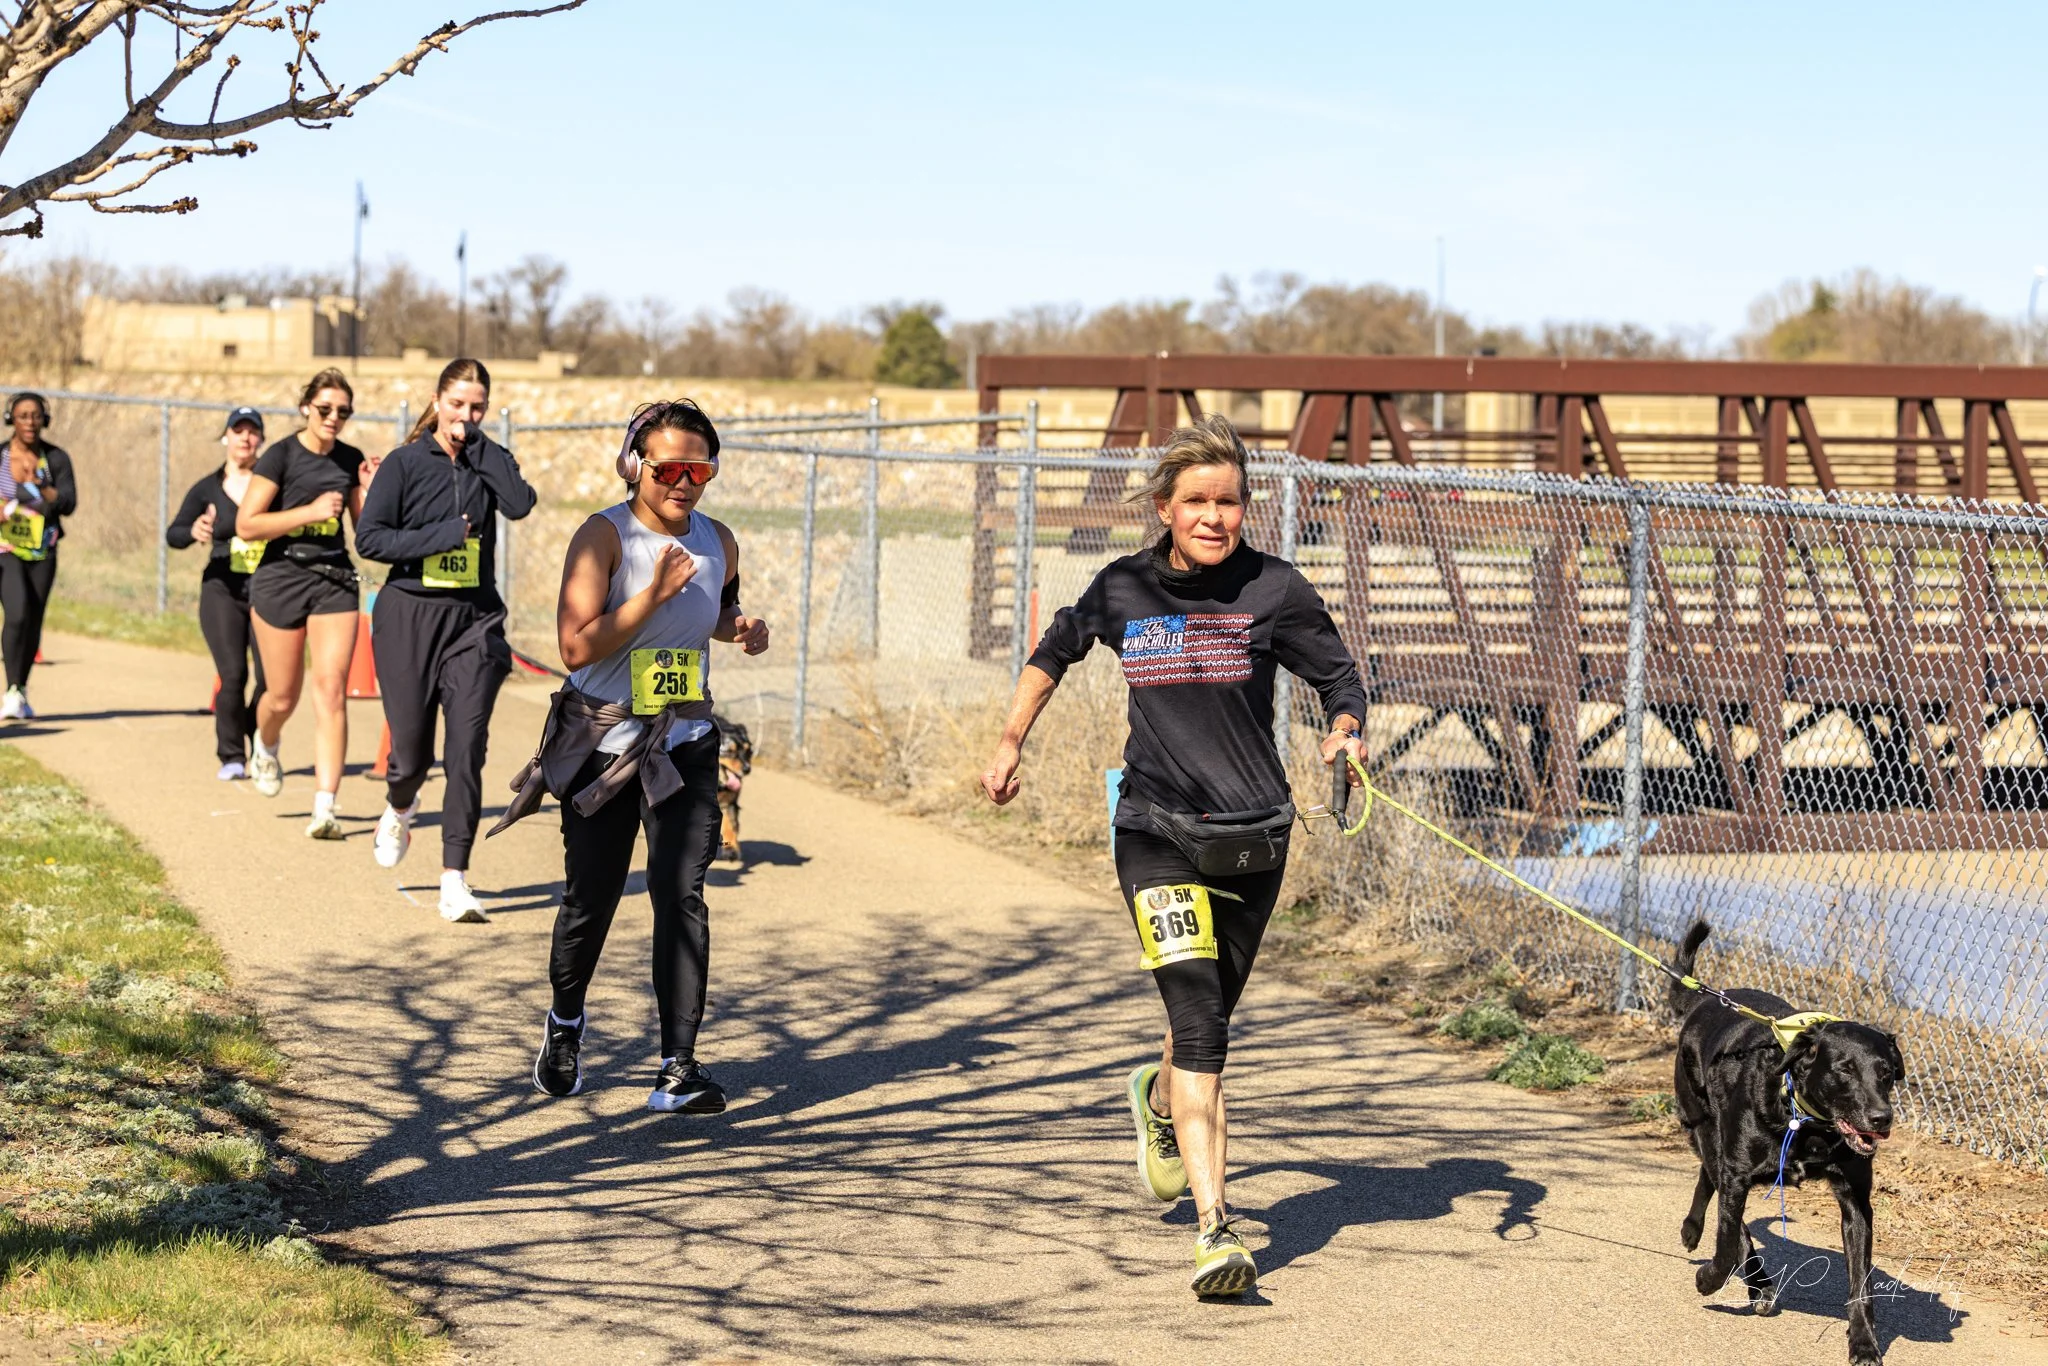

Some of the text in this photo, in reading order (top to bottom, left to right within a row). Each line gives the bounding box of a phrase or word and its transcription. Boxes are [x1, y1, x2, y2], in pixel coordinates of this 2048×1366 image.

[439, 556, 467, 573] 463
[1122, 632, 1184, 650] WINDCHILLER
[677, 653, 690, 666] 5K
[653, 672, 688, 696] 258
[1174, 888, 1194, 904] 5K
[1149, 909, 1200, 943] 369
